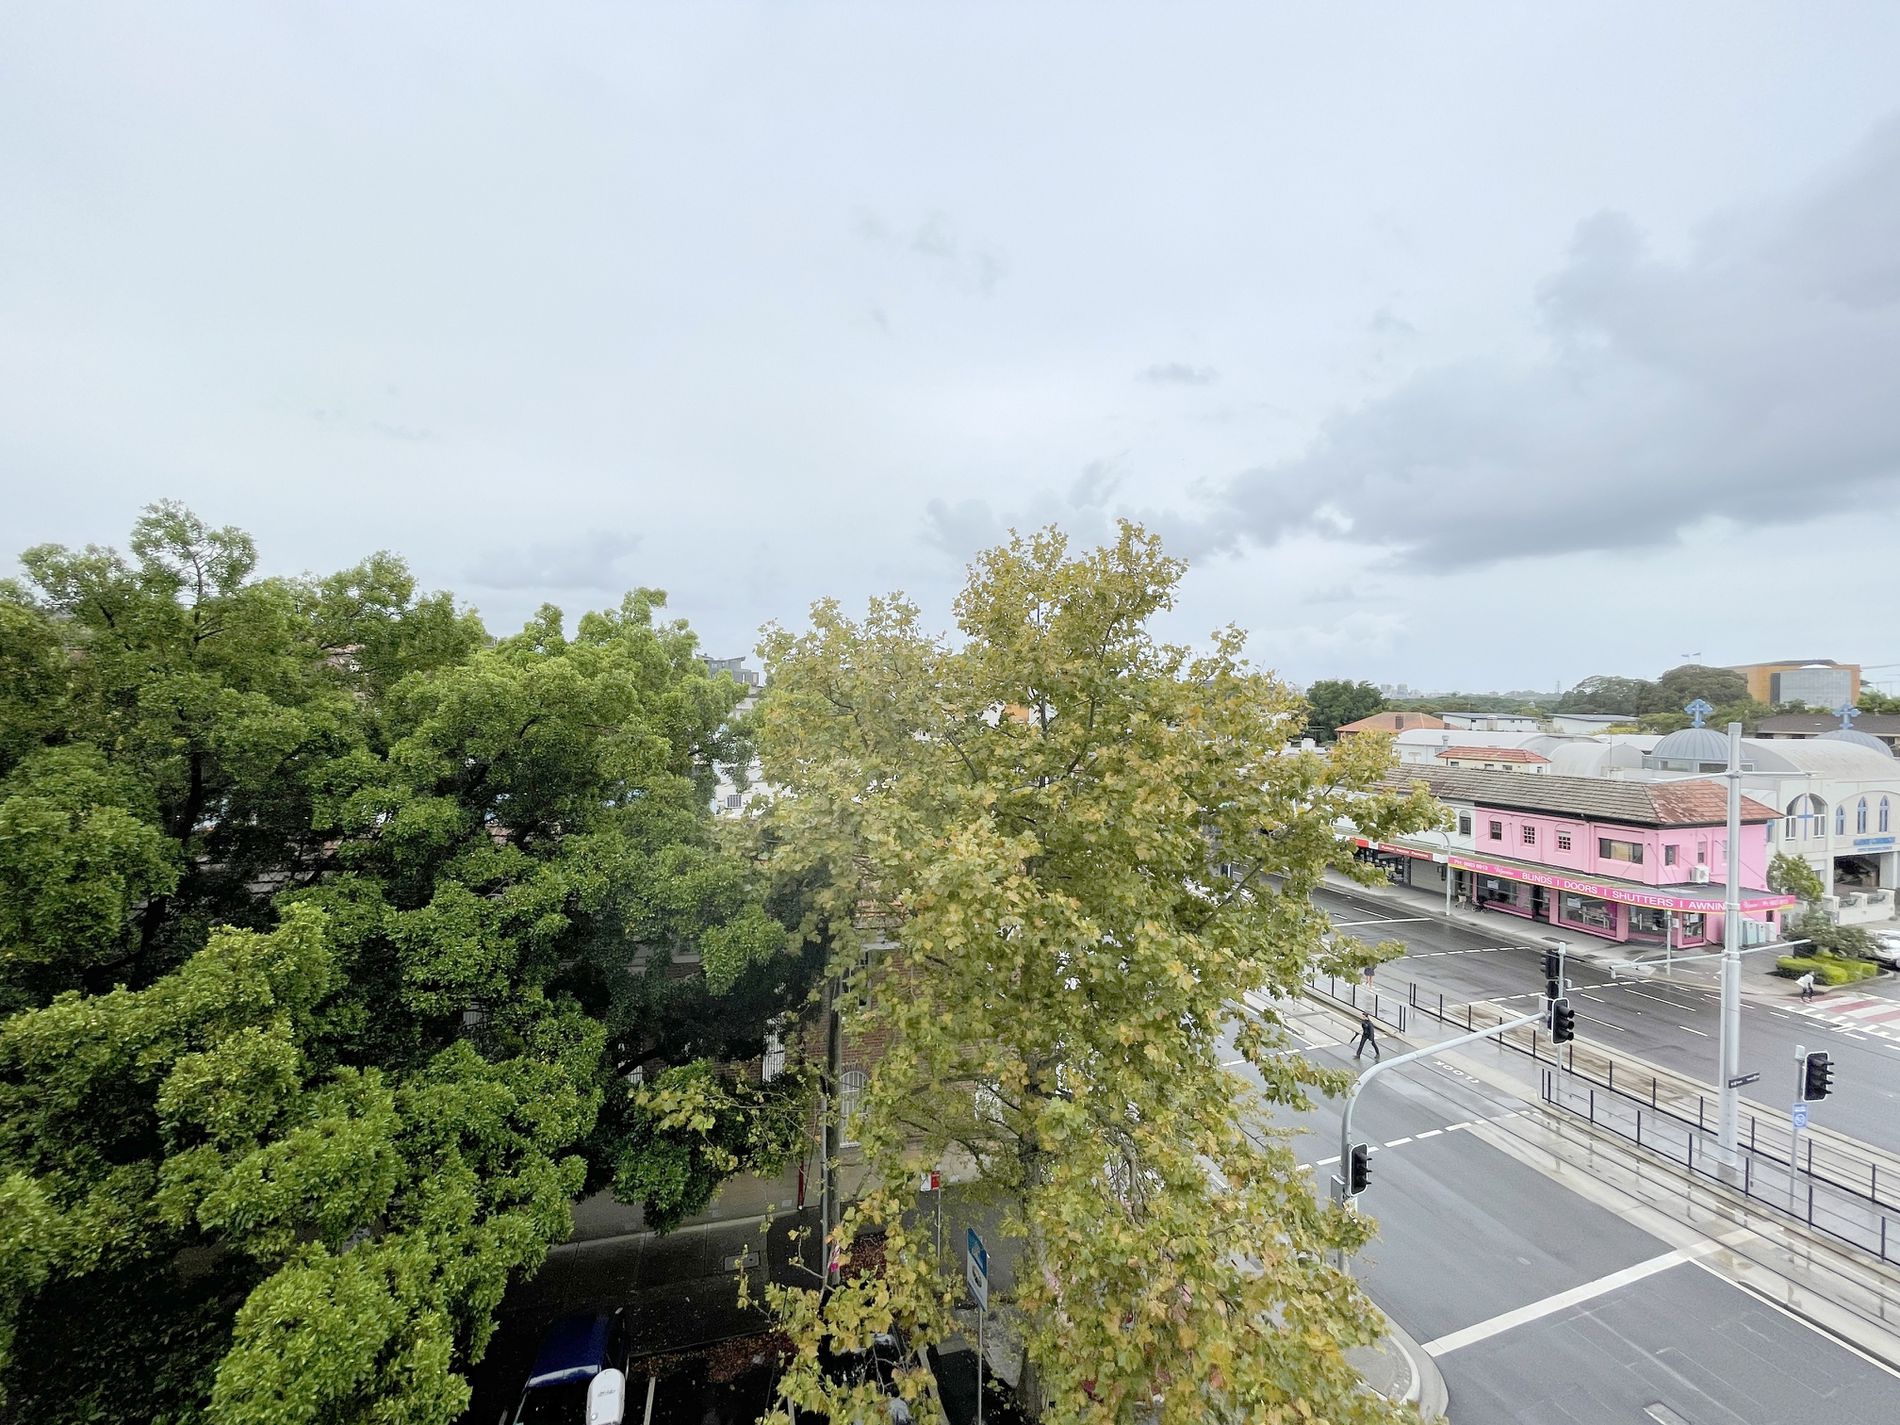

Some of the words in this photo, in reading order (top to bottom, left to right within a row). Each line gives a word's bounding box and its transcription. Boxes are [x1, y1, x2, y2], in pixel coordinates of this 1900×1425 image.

[1522, 872, 1552, 885] BLINDS
[1564, 881, 1598, 895] DOORS
[1612, 890, 1673, 908] SHUTTERS
[1688, 901, 1727, 911] AWNIN
